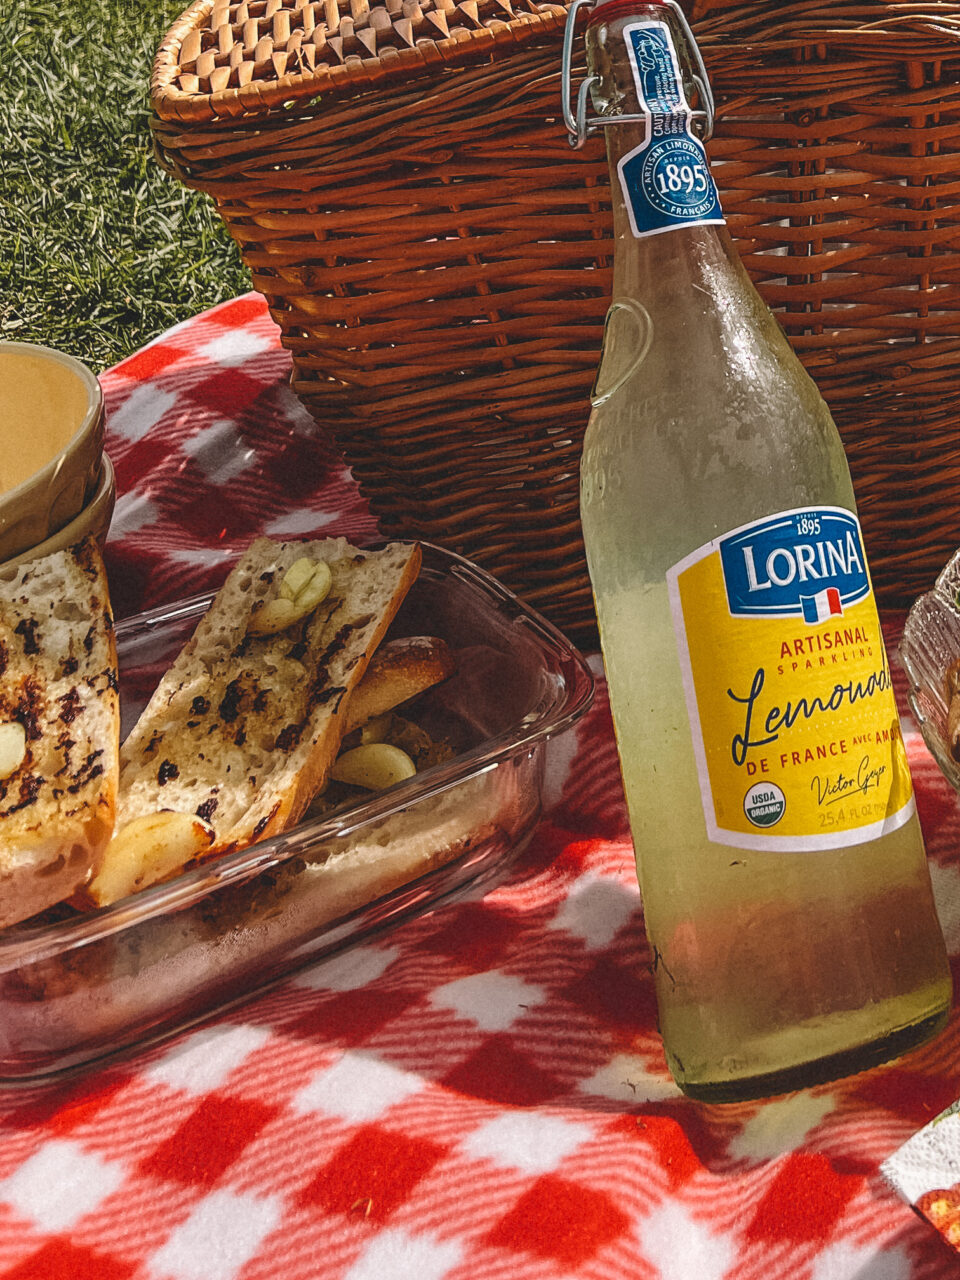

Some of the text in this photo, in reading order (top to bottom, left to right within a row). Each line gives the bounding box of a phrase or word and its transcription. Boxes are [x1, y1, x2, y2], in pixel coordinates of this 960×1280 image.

[644, 146, 664, 183] ARTISAN
[657, 163, 707, 194] 1895
[796, 518, 821, 536] 1895
[742, 530, 864, 592] LORINA
[780, 626, 869, 659] ARTISANAL
[777, 647, 873, 675] SPARKLING
[726, 624, 891, 766] Lemonad
[746, 725, 901, 776] DE FRANCE AVEC AMOU
[750, 791, 782, 818] USDA ORGANIC
[810, 773, 855, 806] Victor
[819, 809, 846, 828] 25,4
[850, 808, 861, 819] FL
[861, 803, 873, 816] OZ
